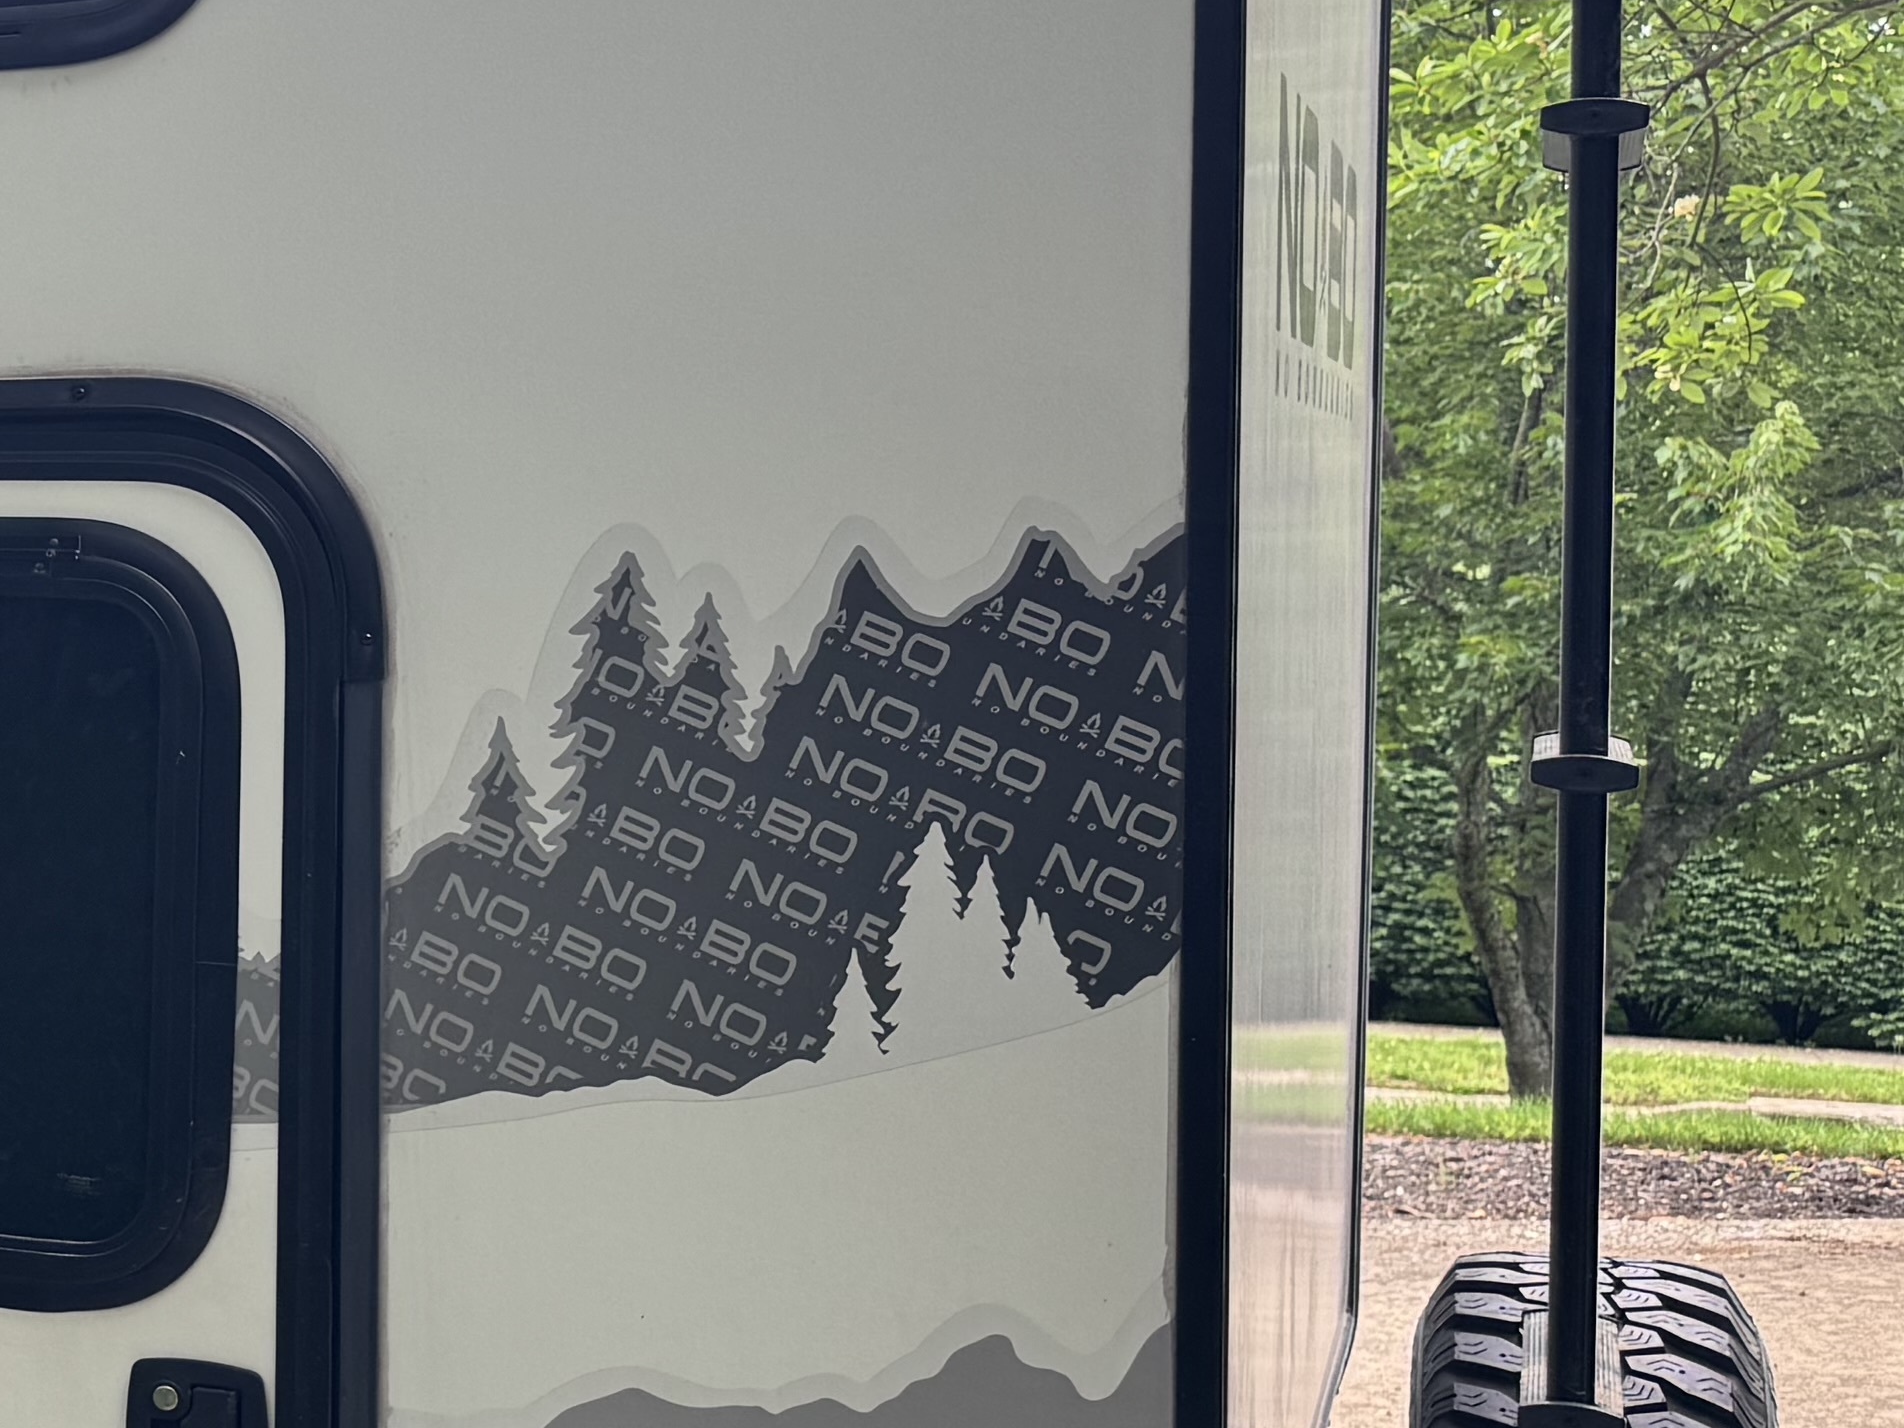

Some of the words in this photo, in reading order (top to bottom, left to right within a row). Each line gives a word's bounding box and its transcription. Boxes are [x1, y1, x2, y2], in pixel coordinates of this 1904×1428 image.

[851, 610, 951, 677] BO
[1007, 598, 1112, 666] BO
[975, 662, 1079, 730] NO
[818, 673, 921, 740] NO
[943, 725, 1047, 795] BO
[789, 735, 889, 803] NO
[609, 805, 706, 871] BO
[637, 745, 736, 812] NO
[759, 797, 858, 864] BO
[1072, 779, 1178, 848] NO
[728, 858, 828, 924] NO
[1039, 842, 1145, 913] NO
[437, 872, 530, 937] NO
[551, 924, 647, 992] BO
[580, 865, 677, 932] NO
[698, 918, 798, 987] BO
[410, 930, 504, 996] BO
[384, 988, 475, 1054] NO
[525, 983, 620, 1051] NO
[672, 978, 768, 1047] NO
